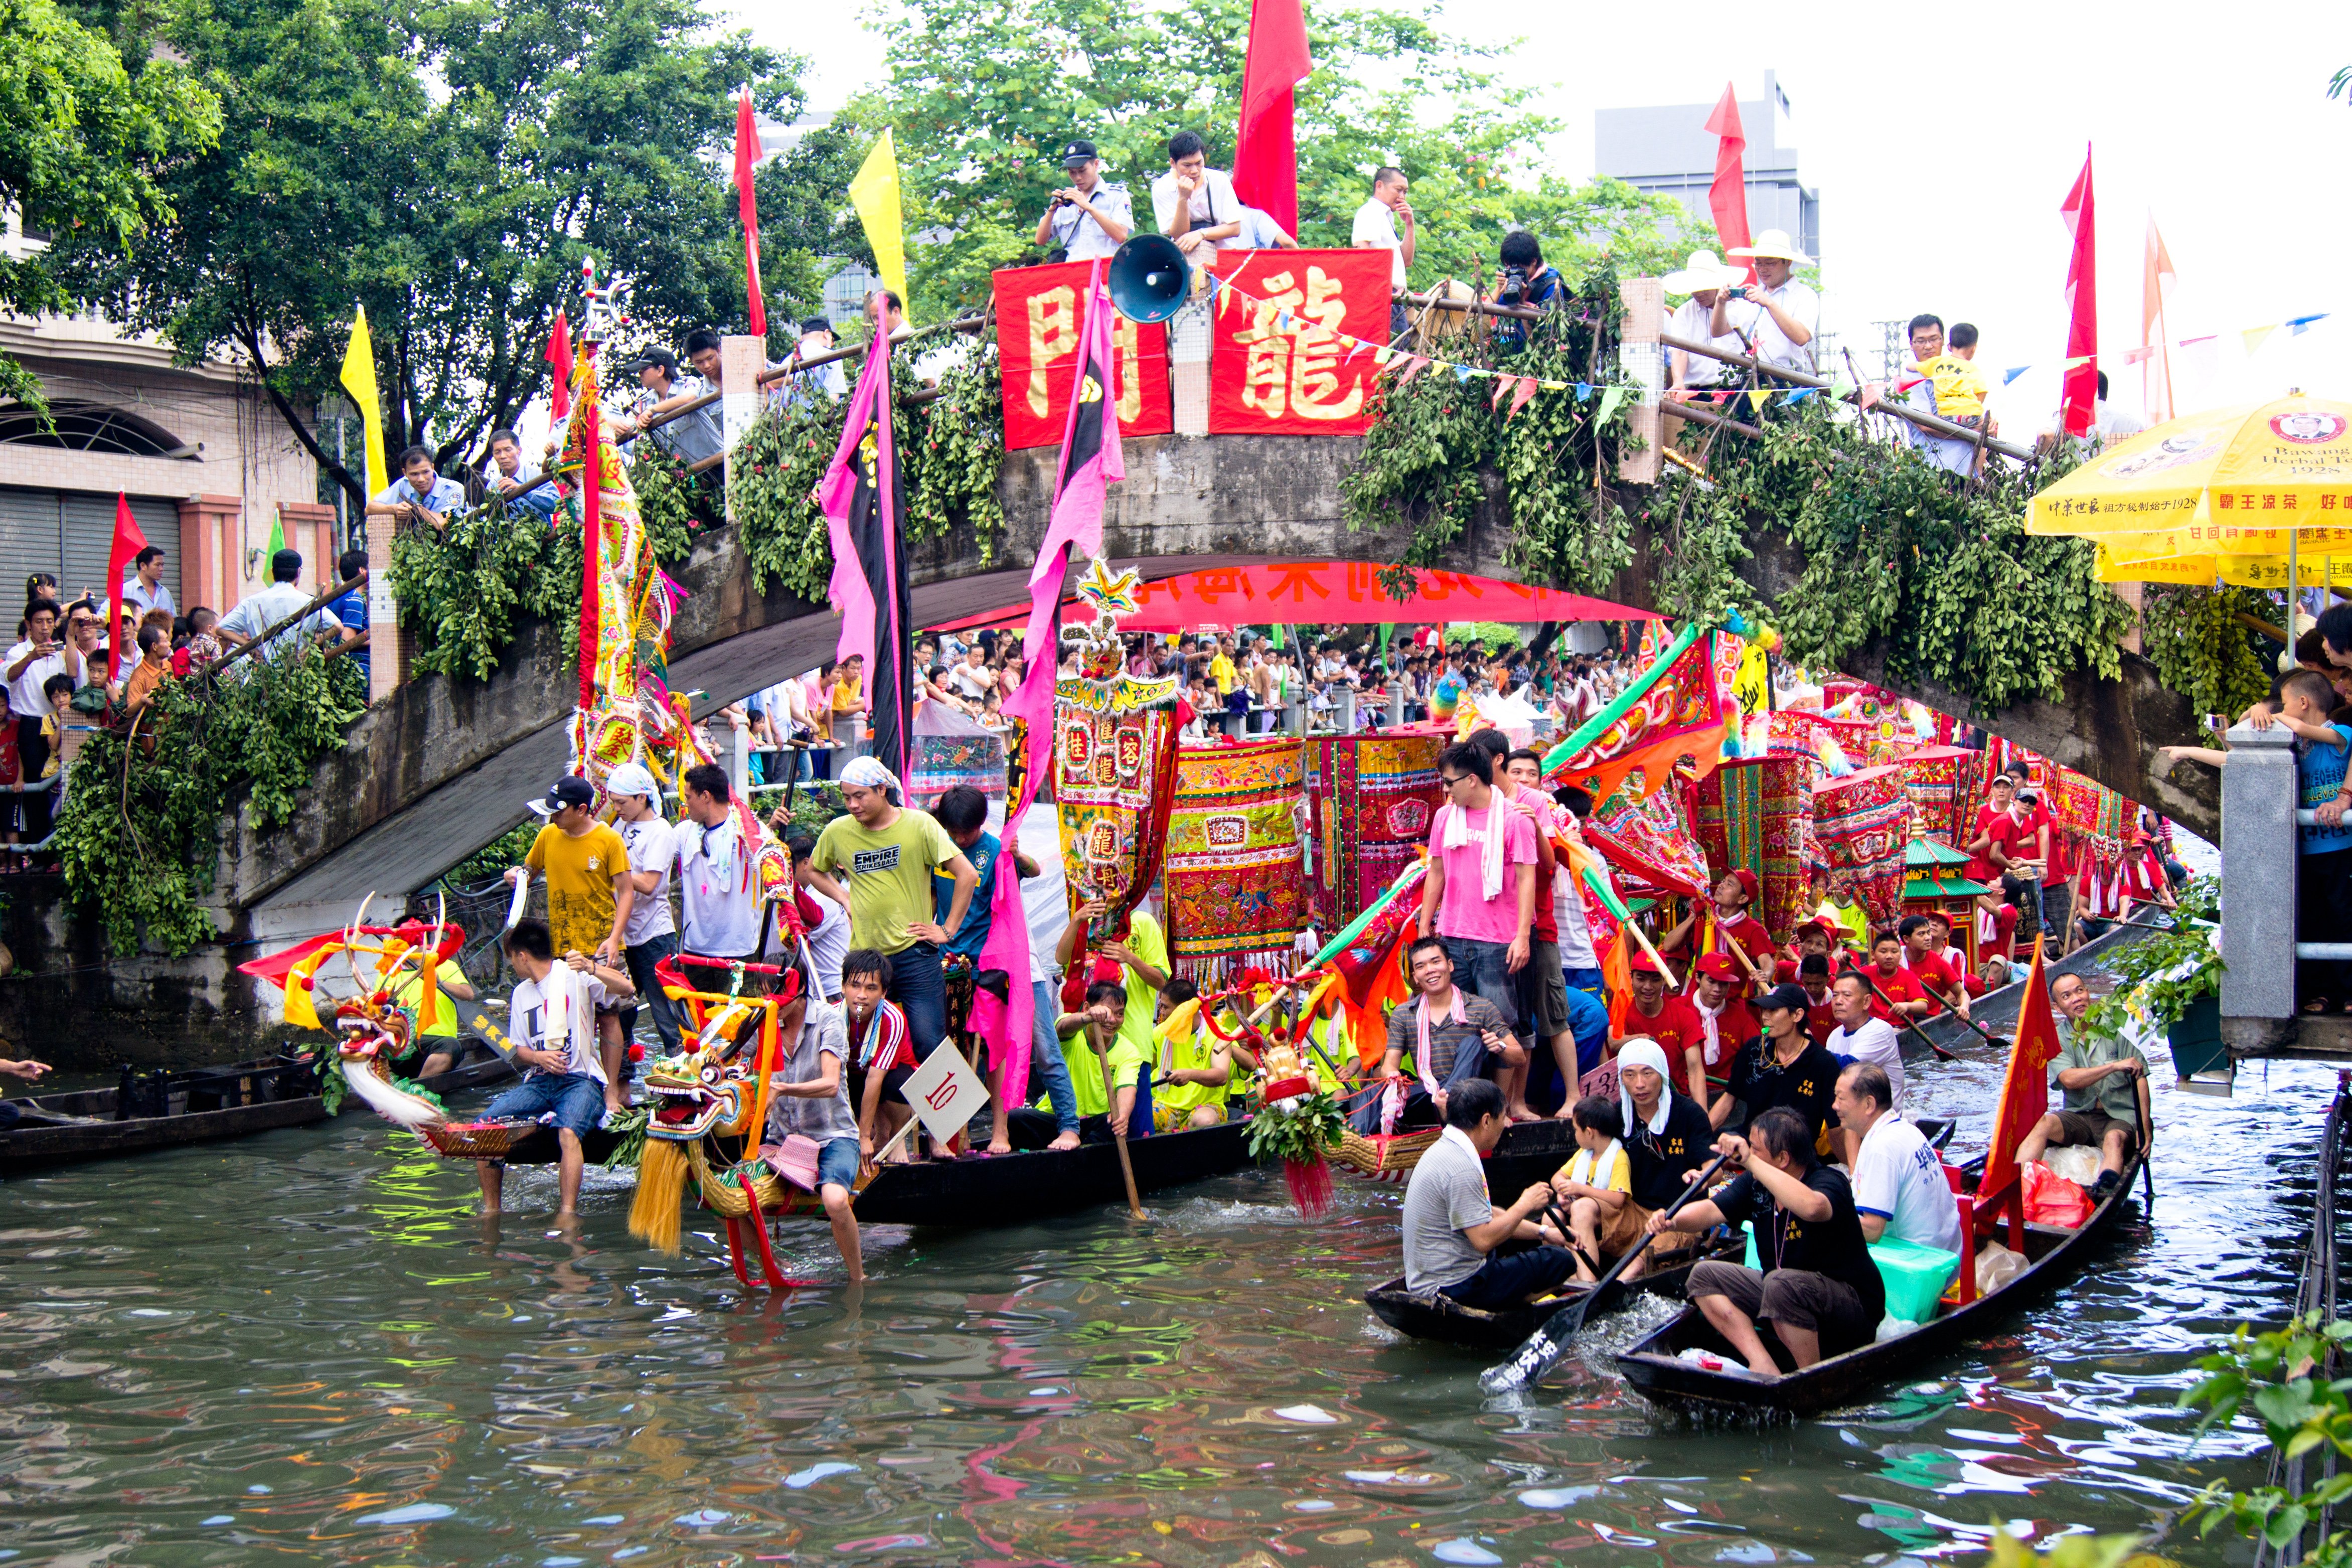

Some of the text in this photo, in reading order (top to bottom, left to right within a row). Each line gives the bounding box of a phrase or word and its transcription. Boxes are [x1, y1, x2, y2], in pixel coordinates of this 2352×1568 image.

[1232, 266, 1363, 419] 龍
[2275, 447, 2350, 455] Bawang
[2263, 455, 2324, 464] Herbal
[2220, 494, 2297, 510] 霸王凉茶
[1070, 731, 1085, 758] 桂
[1121, 737, 1139, 765] 容
[854, 849, 899, 865] EMPIRE
[855, 857, 898, 871] STRIKES BACK
[925, 1071, 958, 1111] 10
